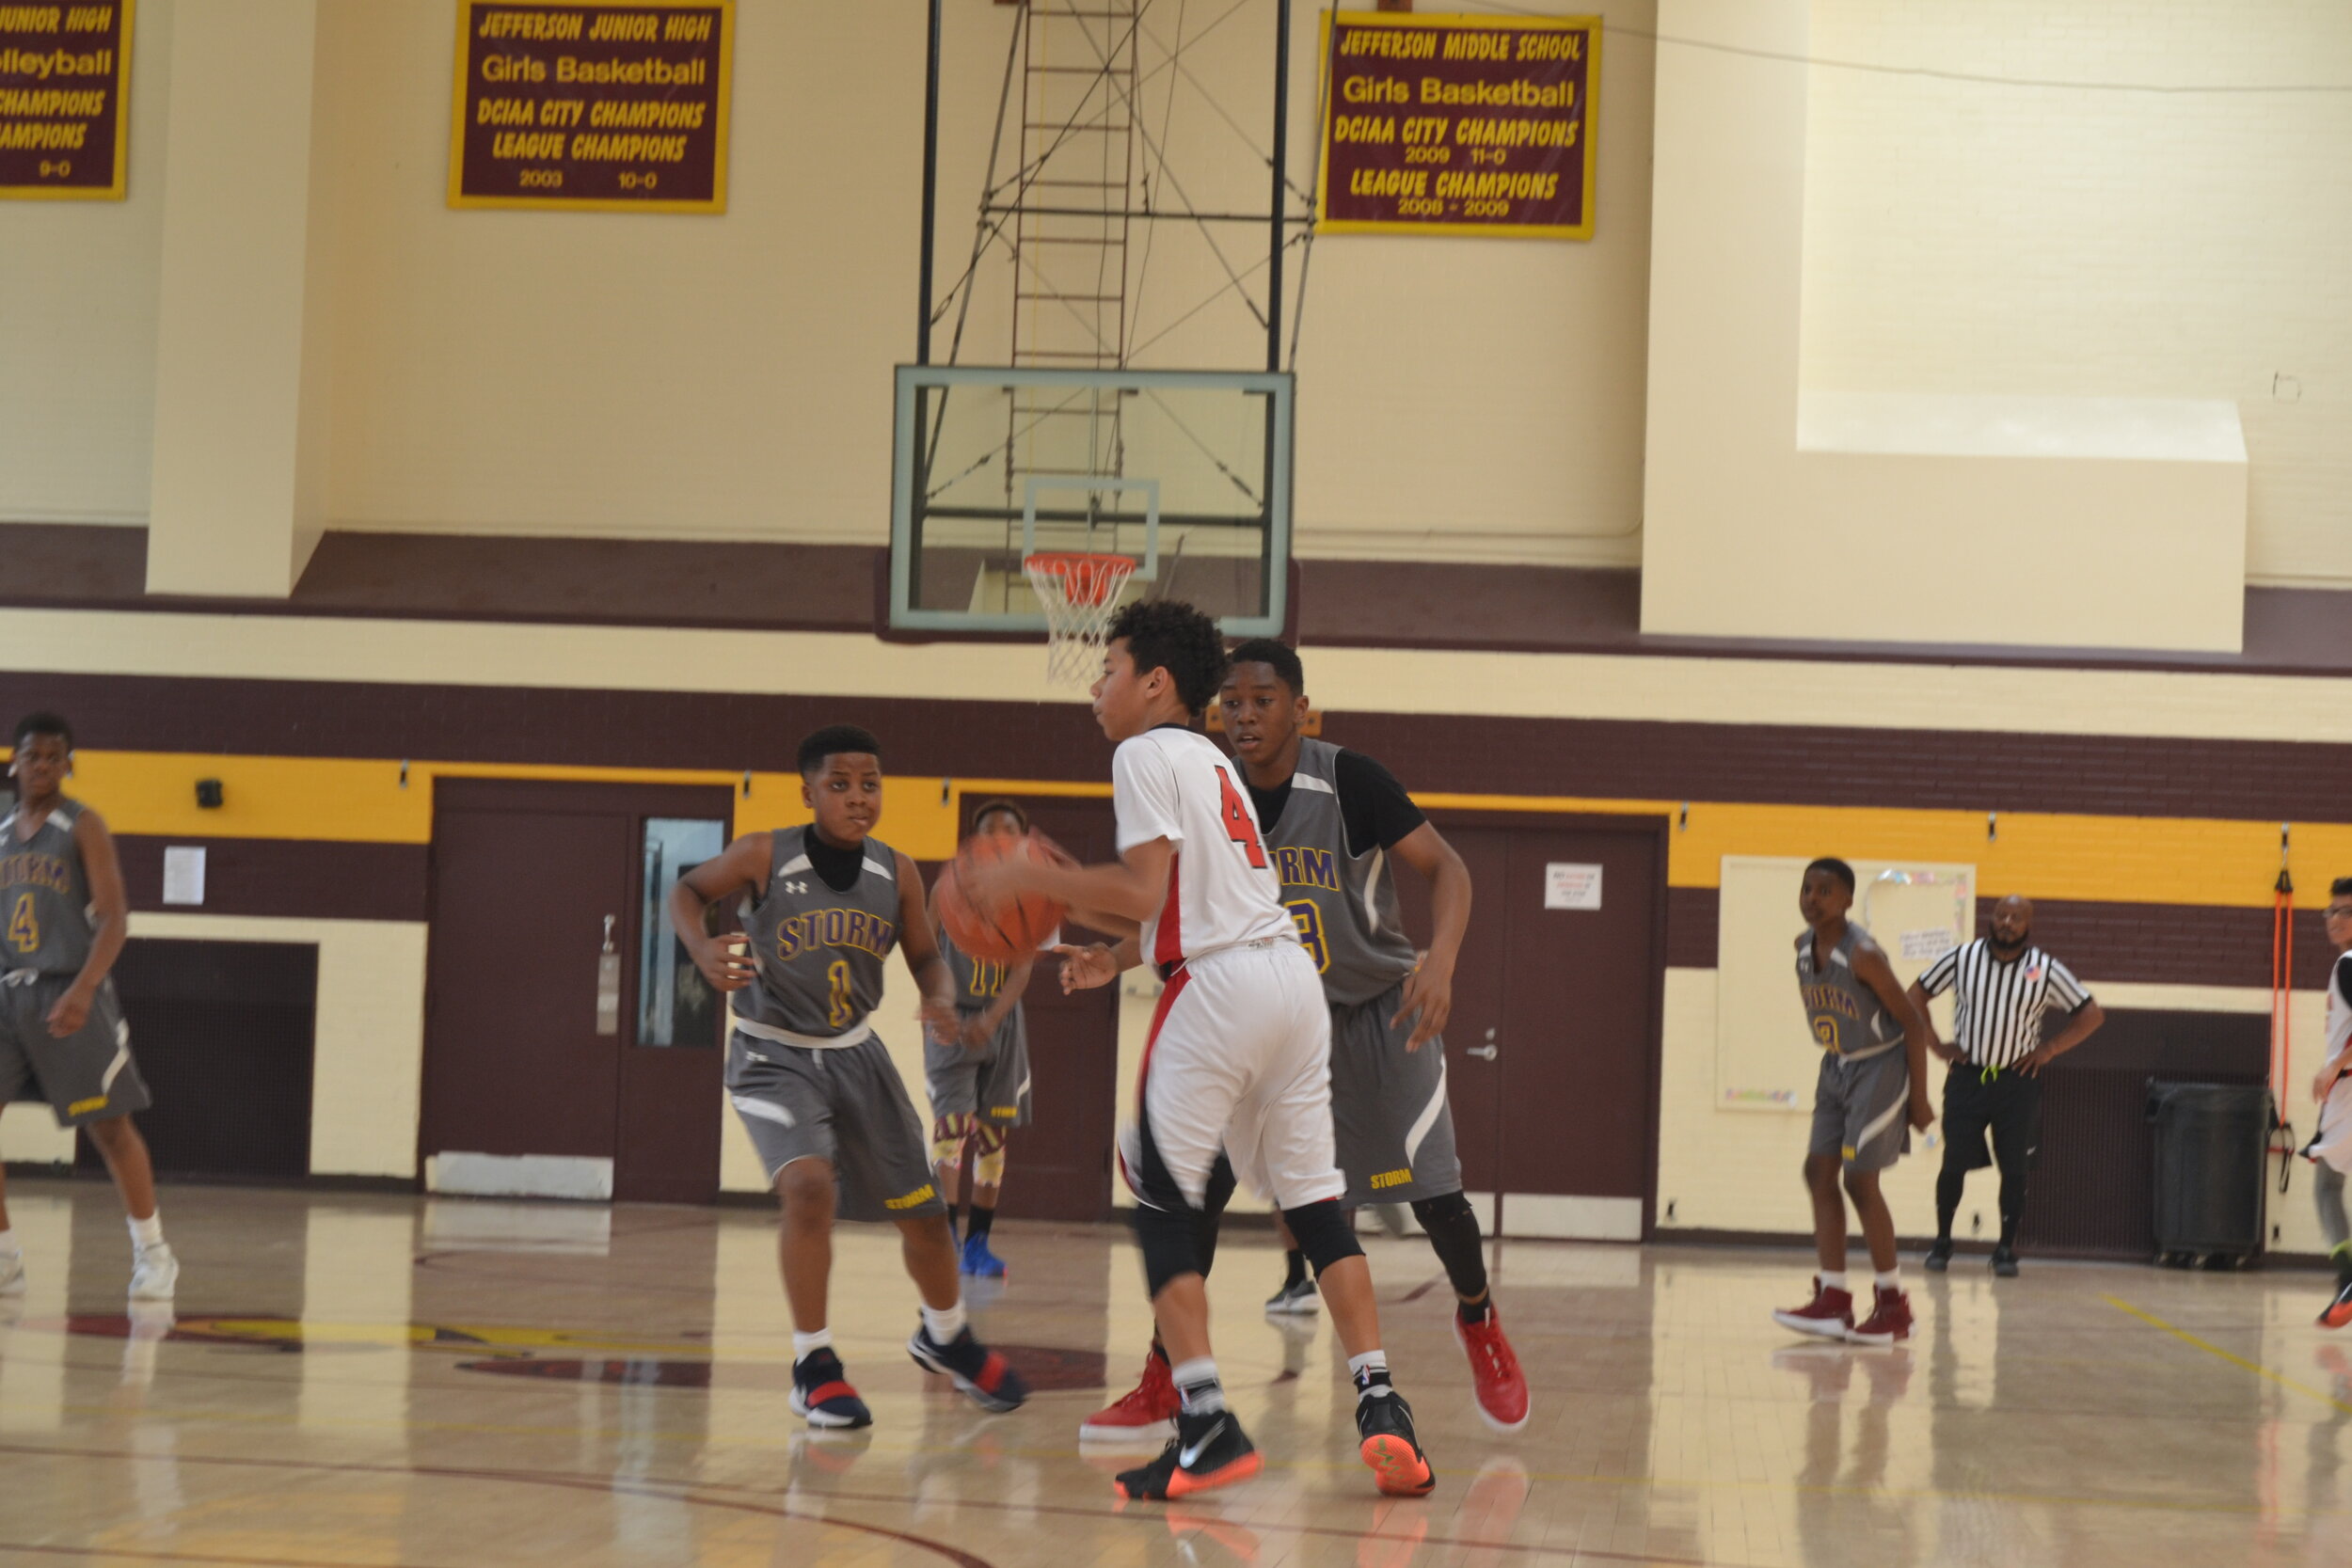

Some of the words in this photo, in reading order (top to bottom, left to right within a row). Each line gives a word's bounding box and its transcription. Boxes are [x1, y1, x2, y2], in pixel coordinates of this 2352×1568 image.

[66, 7, 113, 32] HIGH
[479, 12, 583, 40] JEFFERSON
[589, 13, 660, 42] JUNIOR
[664, 14, 712, 41] HIGH
[1340, 29, 1438, 59] JEFFERSON
[1442, 31, 1511, 60] MIDDLE
[1517, 33, 1581, 61] SCHOOL
[0, 48, 112, 79] lleyball
[482, 55, 547, 83] Girls
[556, 55, 706, 86] Basketball
[1343, 75, 1409, 104] Girls
[1421, 76, 1574, 107] Basketball
[477, 98, 534, 126] DCIAA
[540, 100, 584, 127] CITY
[590, 100, 706, 129] CHAMPIONS
[1334, 115, 1395, 144] DCIAA
[1402, 117, 1449, 145] CITY
[1455, 118, 1580, 148] CHAMPIONS
[492, 132, 566, 160] LEAGUE
[571, 134, 688, 163] CHAMPIONS
[1405, 145, 1451, 165] 2009
[1470, 147, 1507, 166] 11-0
[519, 169, 563, 188] 2003
[618, 171, 658, 190] 10-0
[1350, 167, 1429, 197] LEAGUE
[1436, 169, 1560, 200] CHAMPIONS
[1398, 197, 1444, 216] 2008
[1464, 198, 1510, 217] 2009
[1214, 764, 1269, 870] 4
[8, 892, 40, 953] 4
[777, 907, 895, 962] STORM
[828, 959, 853, 1027] 1
[1371, 1168, 1413, 1189] STORM
[884, 1183, 935, 1210] STORM
